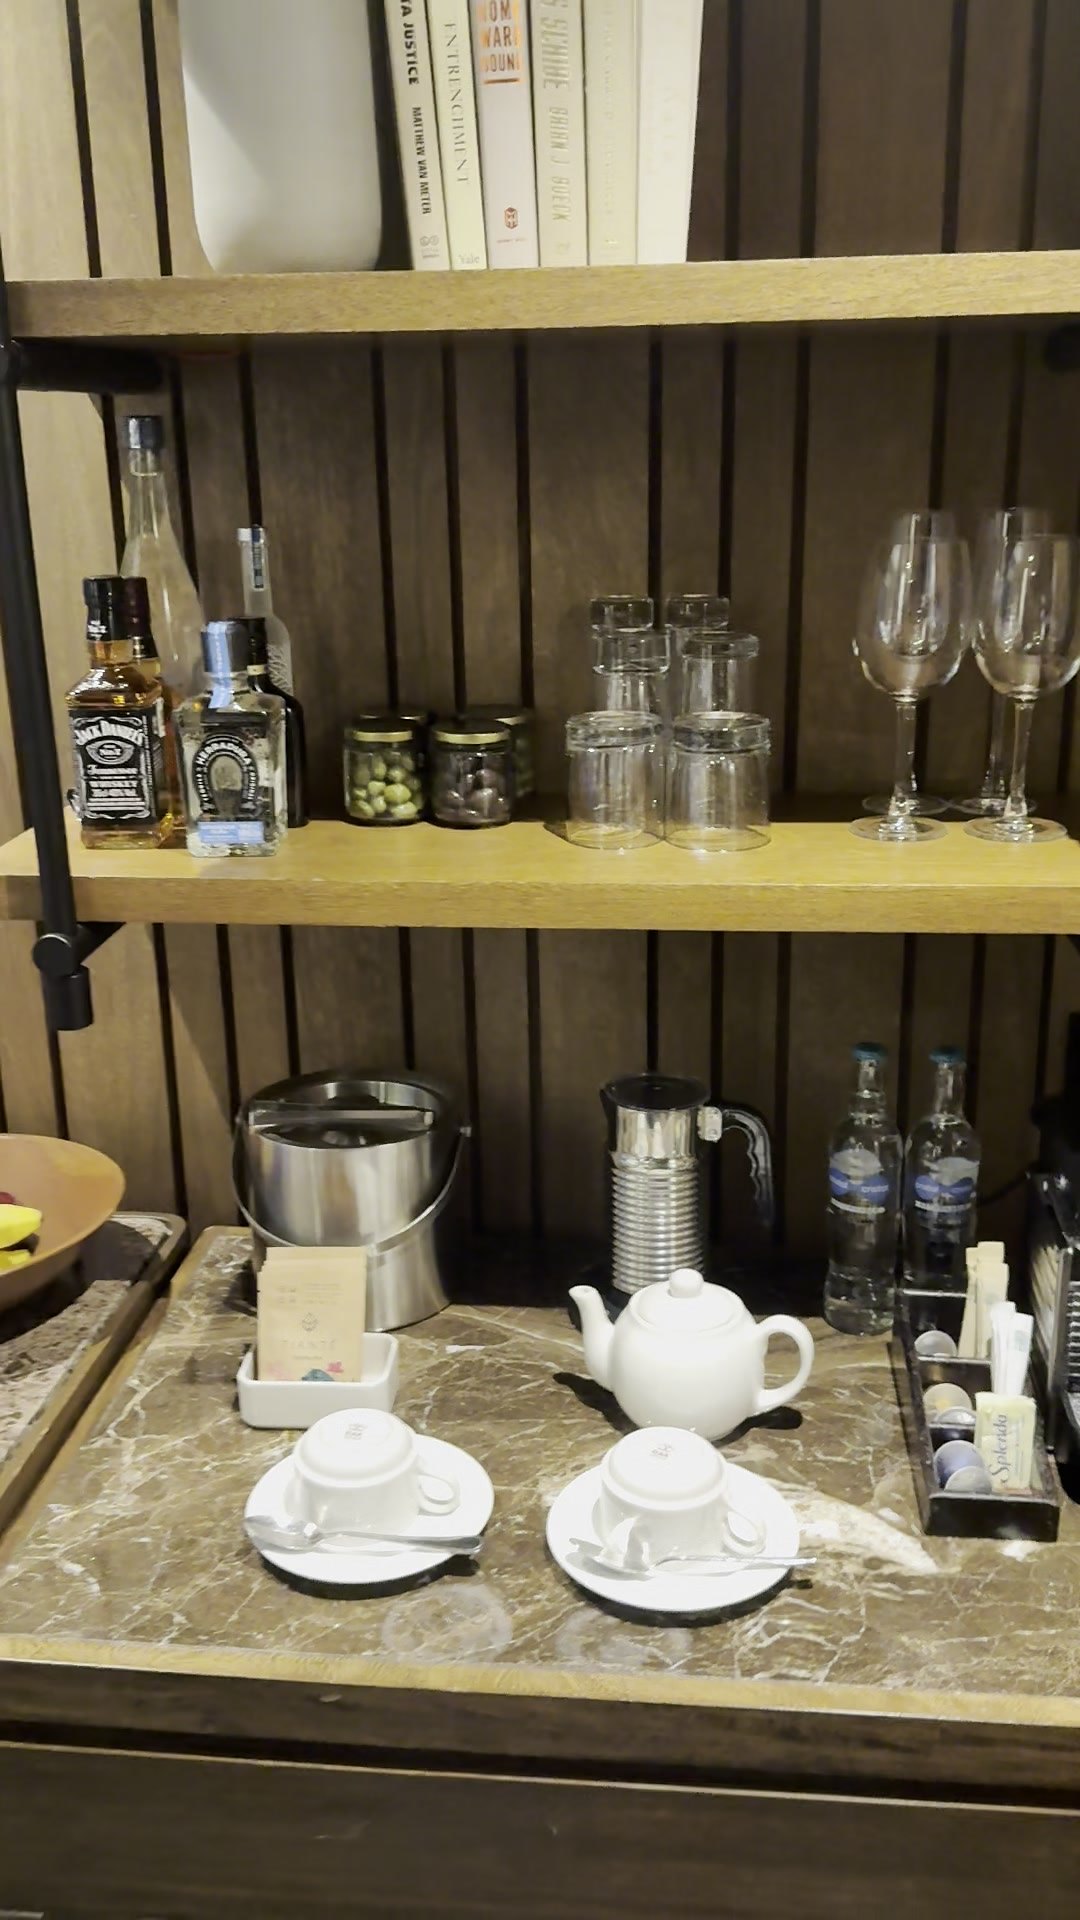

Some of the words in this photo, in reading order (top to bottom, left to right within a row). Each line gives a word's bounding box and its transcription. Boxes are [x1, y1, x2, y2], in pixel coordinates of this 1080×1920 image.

[402, 23, 420, 86] JUSTICE
[444, 22, 469, 183] ENTRENCHMENT
[411, 106, 426, 156] MATTHEW
[549, 107, 569, 149] BRIAN
[417, 159, 428, 179] VAN
[419, 181, 431, 215] METER
[74, 725, 101, 746] JACK
[987, 1414, 1012, 1485] Splenda
